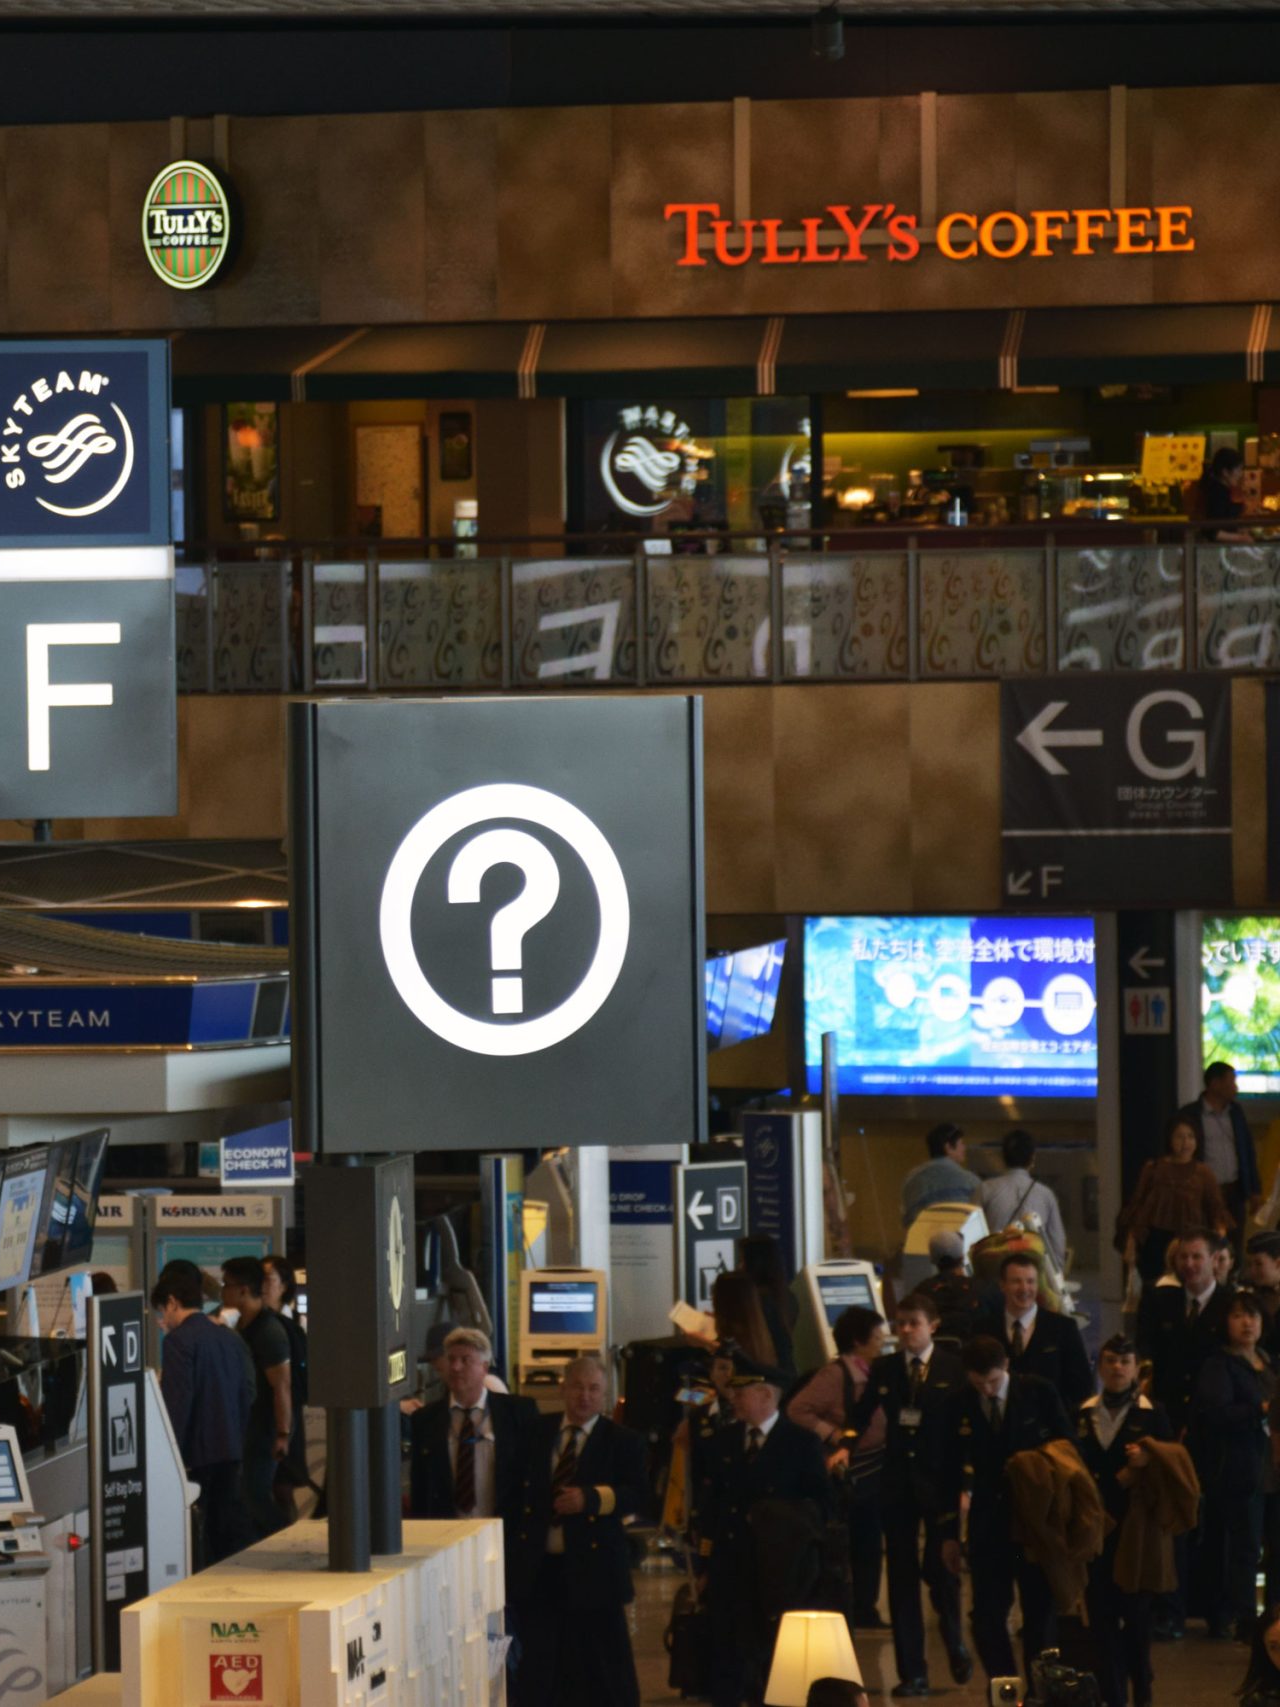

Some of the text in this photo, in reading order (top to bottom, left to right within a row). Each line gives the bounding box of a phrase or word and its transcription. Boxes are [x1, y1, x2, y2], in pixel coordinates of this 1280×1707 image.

[149, 209, 223, 234] TULLY'S
[665, 203, 1195, 266] TULLY'S COFFEE
[162, 235, 210, 246] COFFEE
[1, 370, 102, 489] SKYTEAM
[26, 622, 121, 771] F
[1126, 689, 1207, 781] G
[1041, 866, 1064, 898] F
[224, 1147, 288, 1160] ECONOMY
[225, 1158, 287, 1171] CHECK-IN
[161, 1205, 246, 1218] KOREAN AIR
[721, 1195, 737, 1222] D
[126, 1330, 138, 1364] D
[214, 1656, 259, 1668] AED
